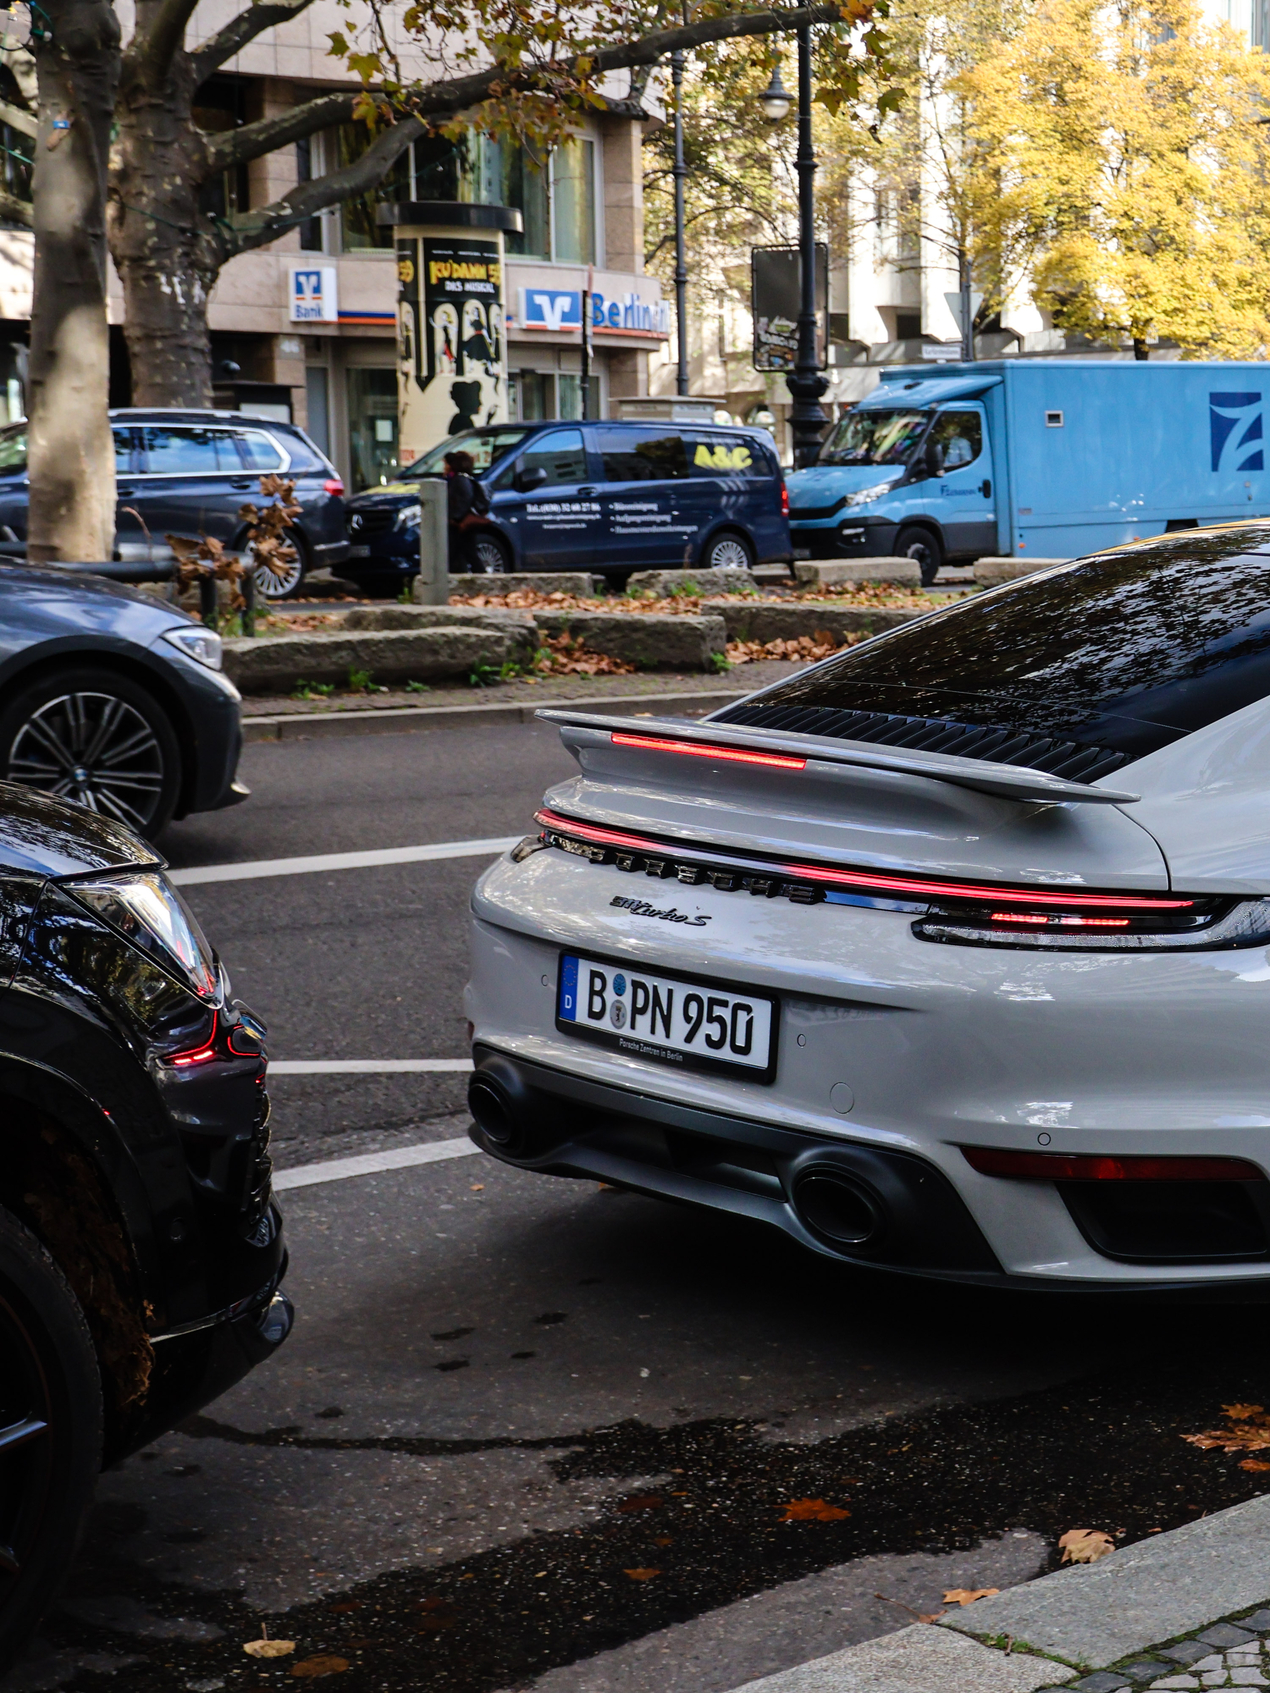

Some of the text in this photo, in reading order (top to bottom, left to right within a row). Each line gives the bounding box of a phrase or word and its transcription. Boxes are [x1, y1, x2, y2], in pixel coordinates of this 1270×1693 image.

[295, 304, 322, 318] Bank
[693, 444, 753, 471] A&C
[564, 994, 573, 1009] D
[587, 969, 754, 1056] B PN 950
[619, 1038, 683, 1062] Porsche Zentren in Berlin
